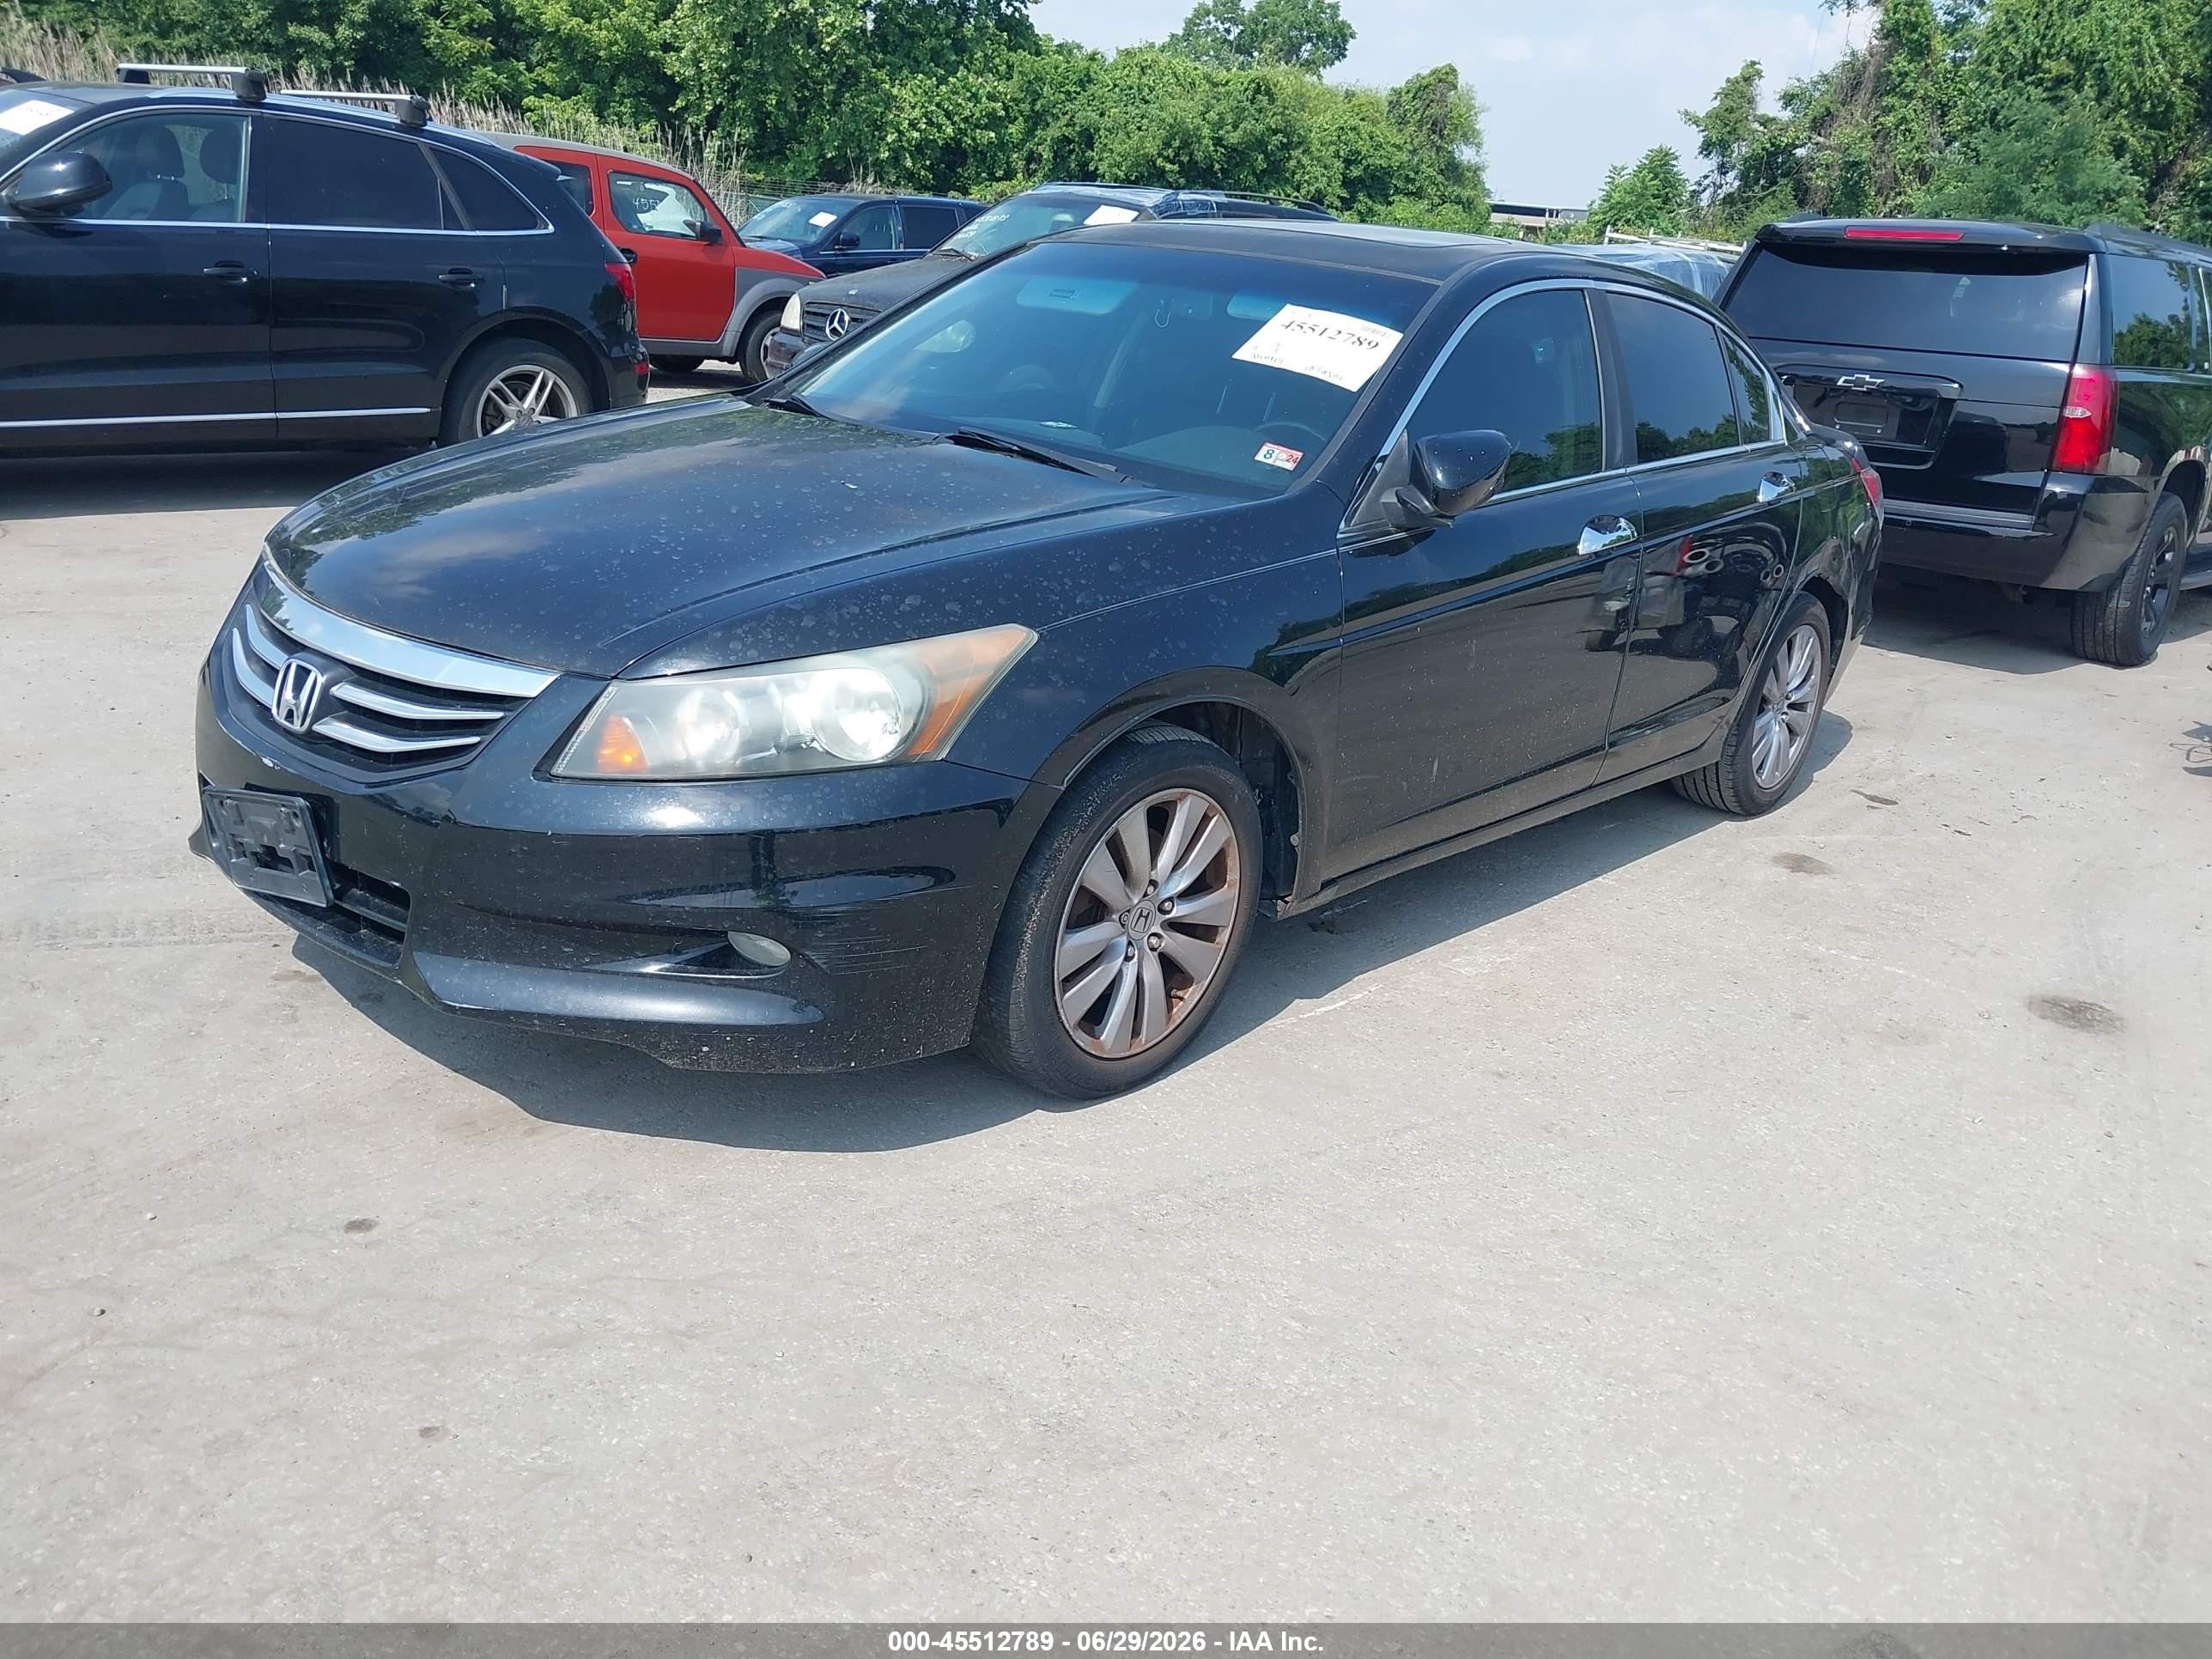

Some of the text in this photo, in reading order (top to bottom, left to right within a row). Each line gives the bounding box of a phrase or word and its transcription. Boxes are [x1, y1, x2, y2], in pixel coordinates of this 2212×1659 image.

[1280, 319, 1380, 350] 45512789
[1263, 448, 1275, 459] 8
[1285, 454, 1299, 465] 24
